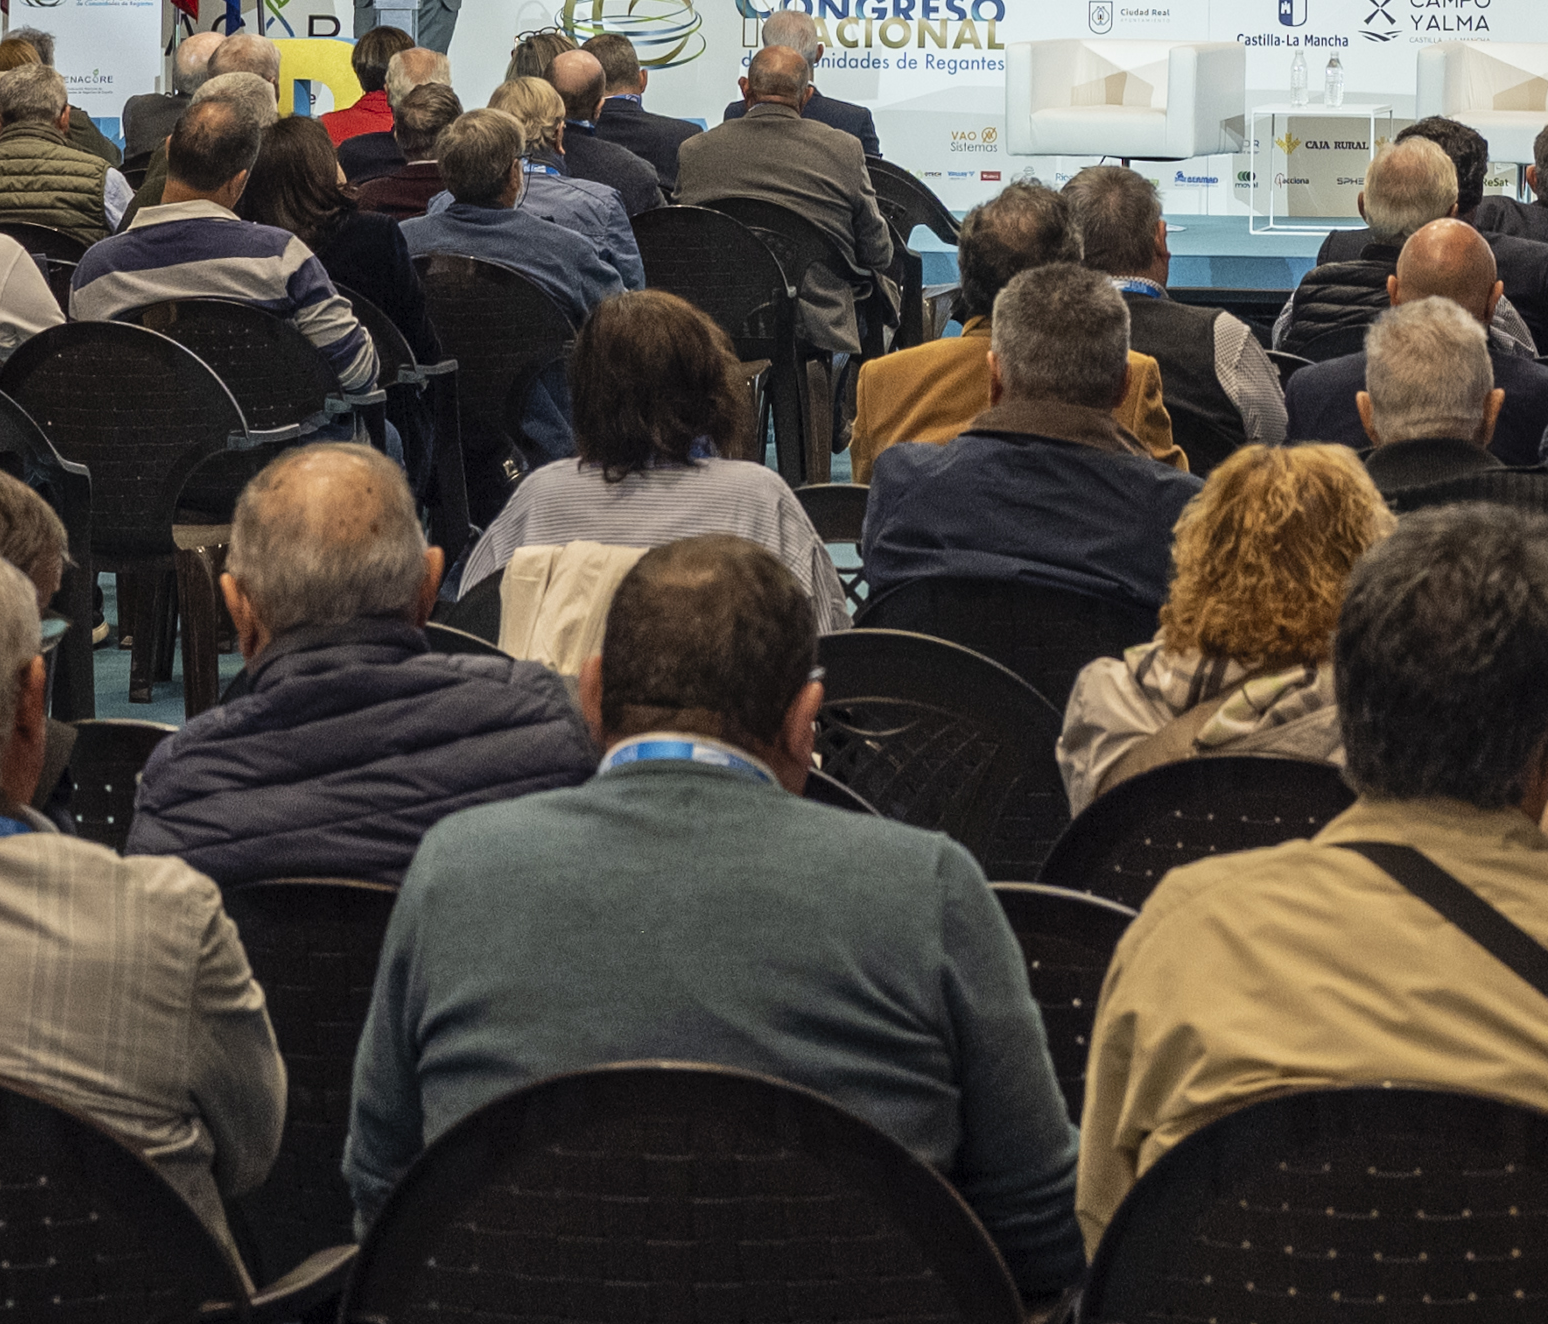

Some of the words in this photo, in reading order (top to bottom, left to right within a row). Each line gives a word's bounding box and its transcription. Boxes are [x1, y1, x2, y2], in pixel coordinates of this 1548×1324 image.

[1120, 7, 1150, 18] Ciudad
[1152, 8, 1170, 18] Real
[1411, 15, 1489, 31] YALMA
[1237, 34, 1299, 46] Castilla-La
[1305, 35, 1348, 47] Mancha
[815, 51, 890, 70] nidades
[896, 52, 918, 71] de
[926, 54, 1005, 76] Regantes
[952, 132, 976, 143] VAO
[951, 141, 997, 152] Sistemas
[1304, 140, 1331, 150] CAJA
[1334, 140, 1369, 150] RURAL
[1282, 176, 1310, 185] acciona
